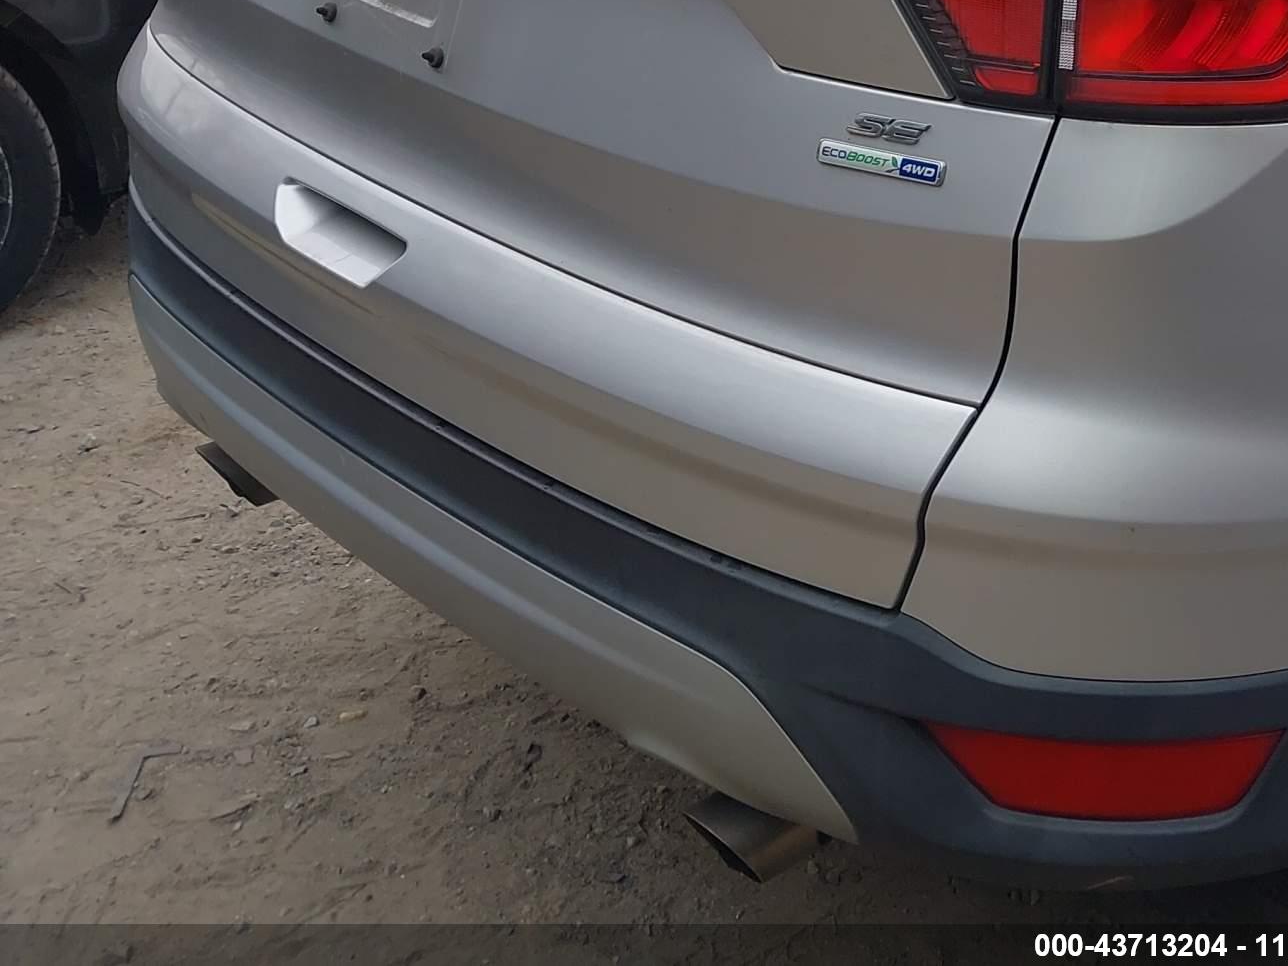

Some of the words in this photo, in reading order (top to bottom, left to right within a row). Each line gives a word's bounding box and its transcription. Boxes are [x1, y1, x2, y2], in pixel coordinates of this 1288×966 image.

[846, 112, 932, 145] SE
[821, 145, 890, 168] ECOBOOST
[902, 163, 936, 178] 4WD
